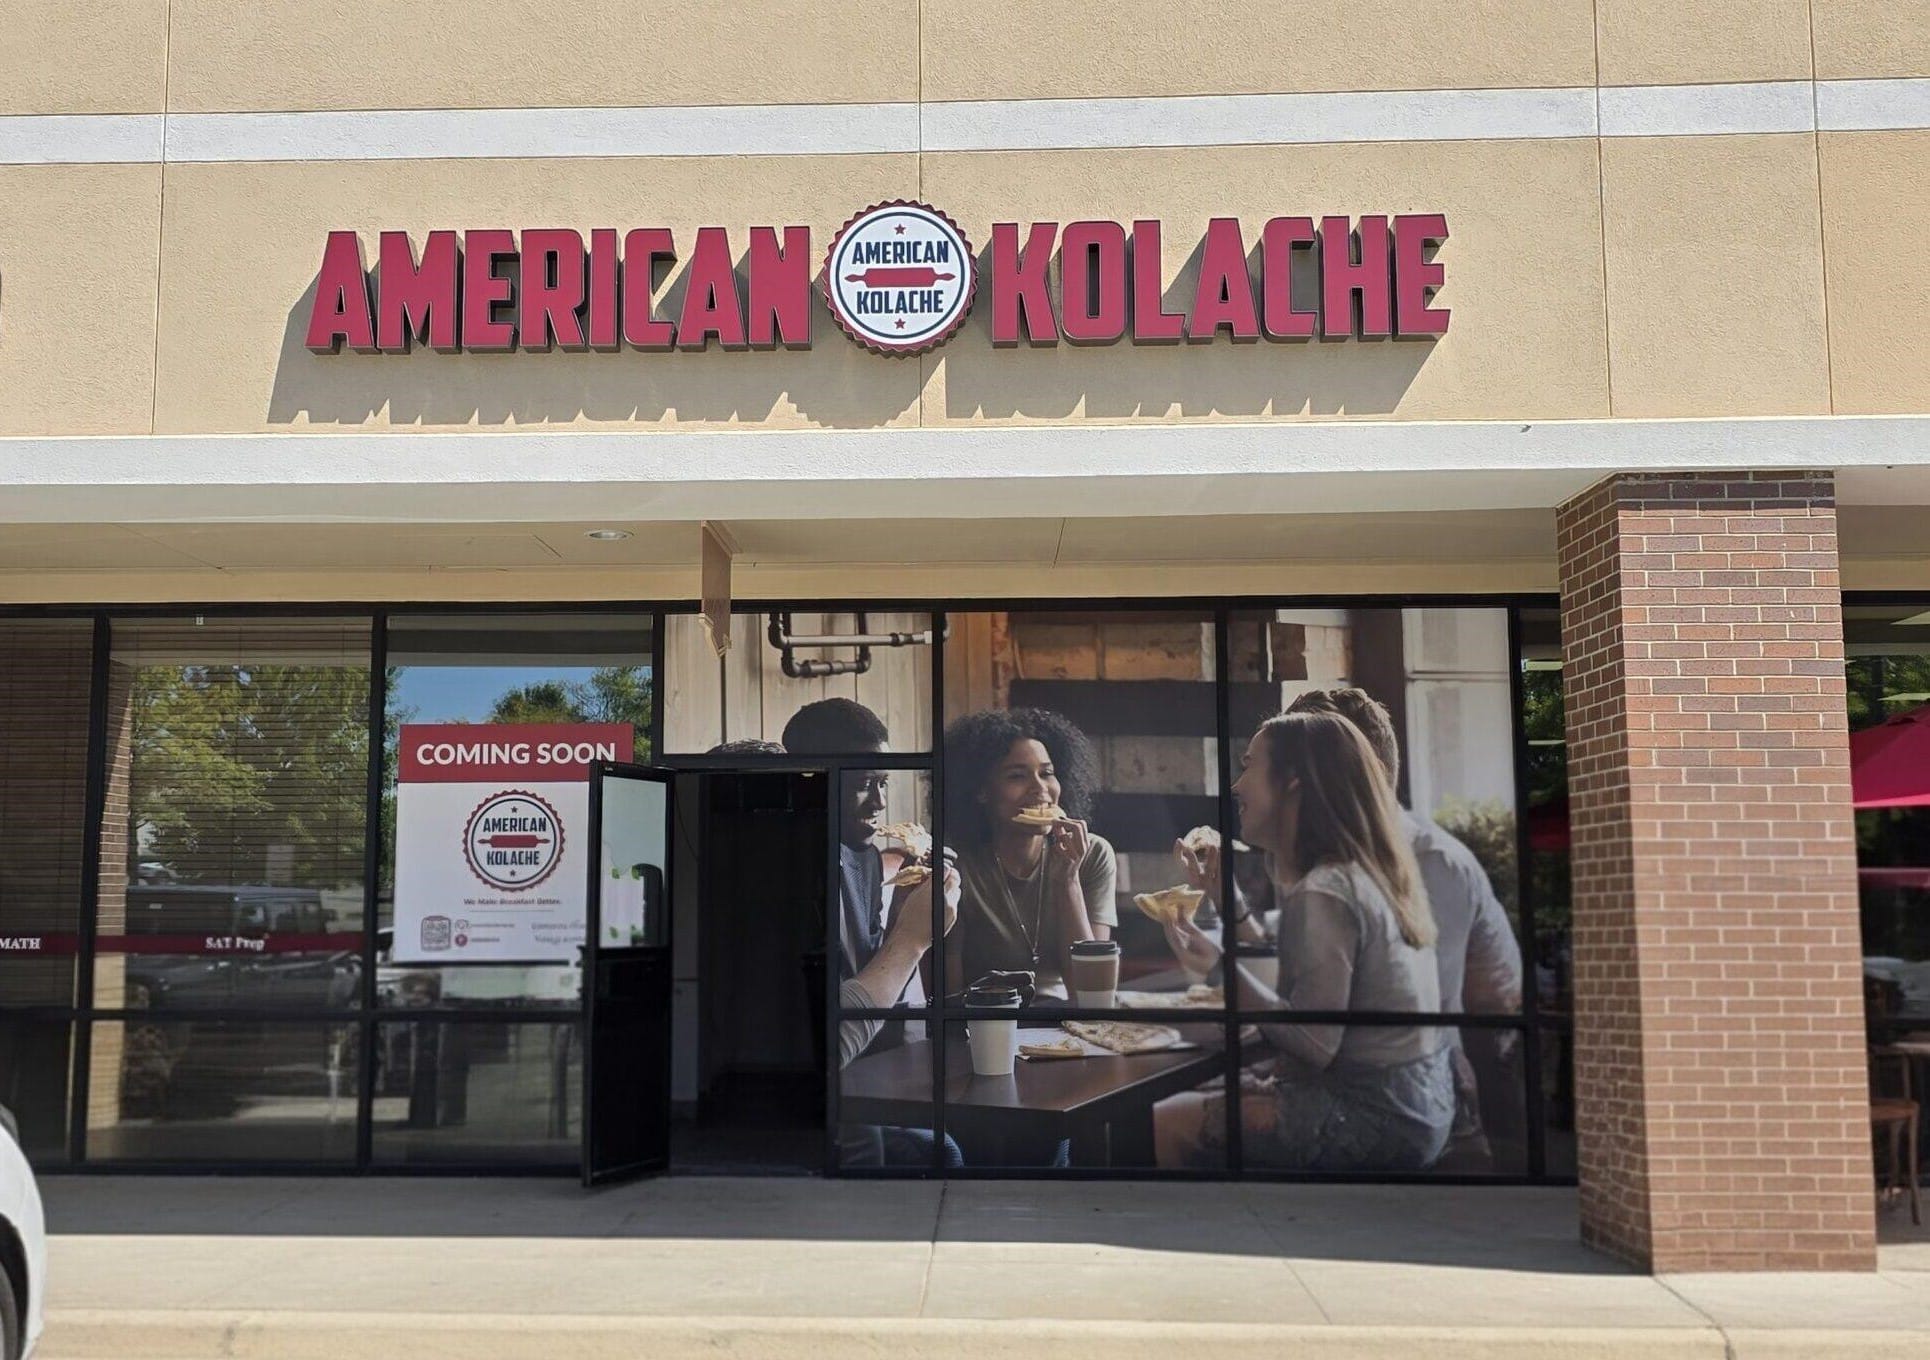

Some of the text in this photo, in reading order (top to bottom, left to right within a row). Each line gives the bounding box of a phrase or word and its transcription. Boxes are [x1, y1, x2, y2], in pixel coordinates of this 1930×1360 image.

[852, 240, 949, 265] AMERICAN
[305, 214, 1451, 354] AMERICAN KOLACHE
[856, 290, 944, 314] KOLACHE
[416, 742, 617, 766] COMING SOON
[482, 817, 548, 833] AMERICAN
[486, 850, 541, 866] KOLACHE
[0, 937, 41, 950] MATH
[205, 936, 265, 952] SAT Prep
